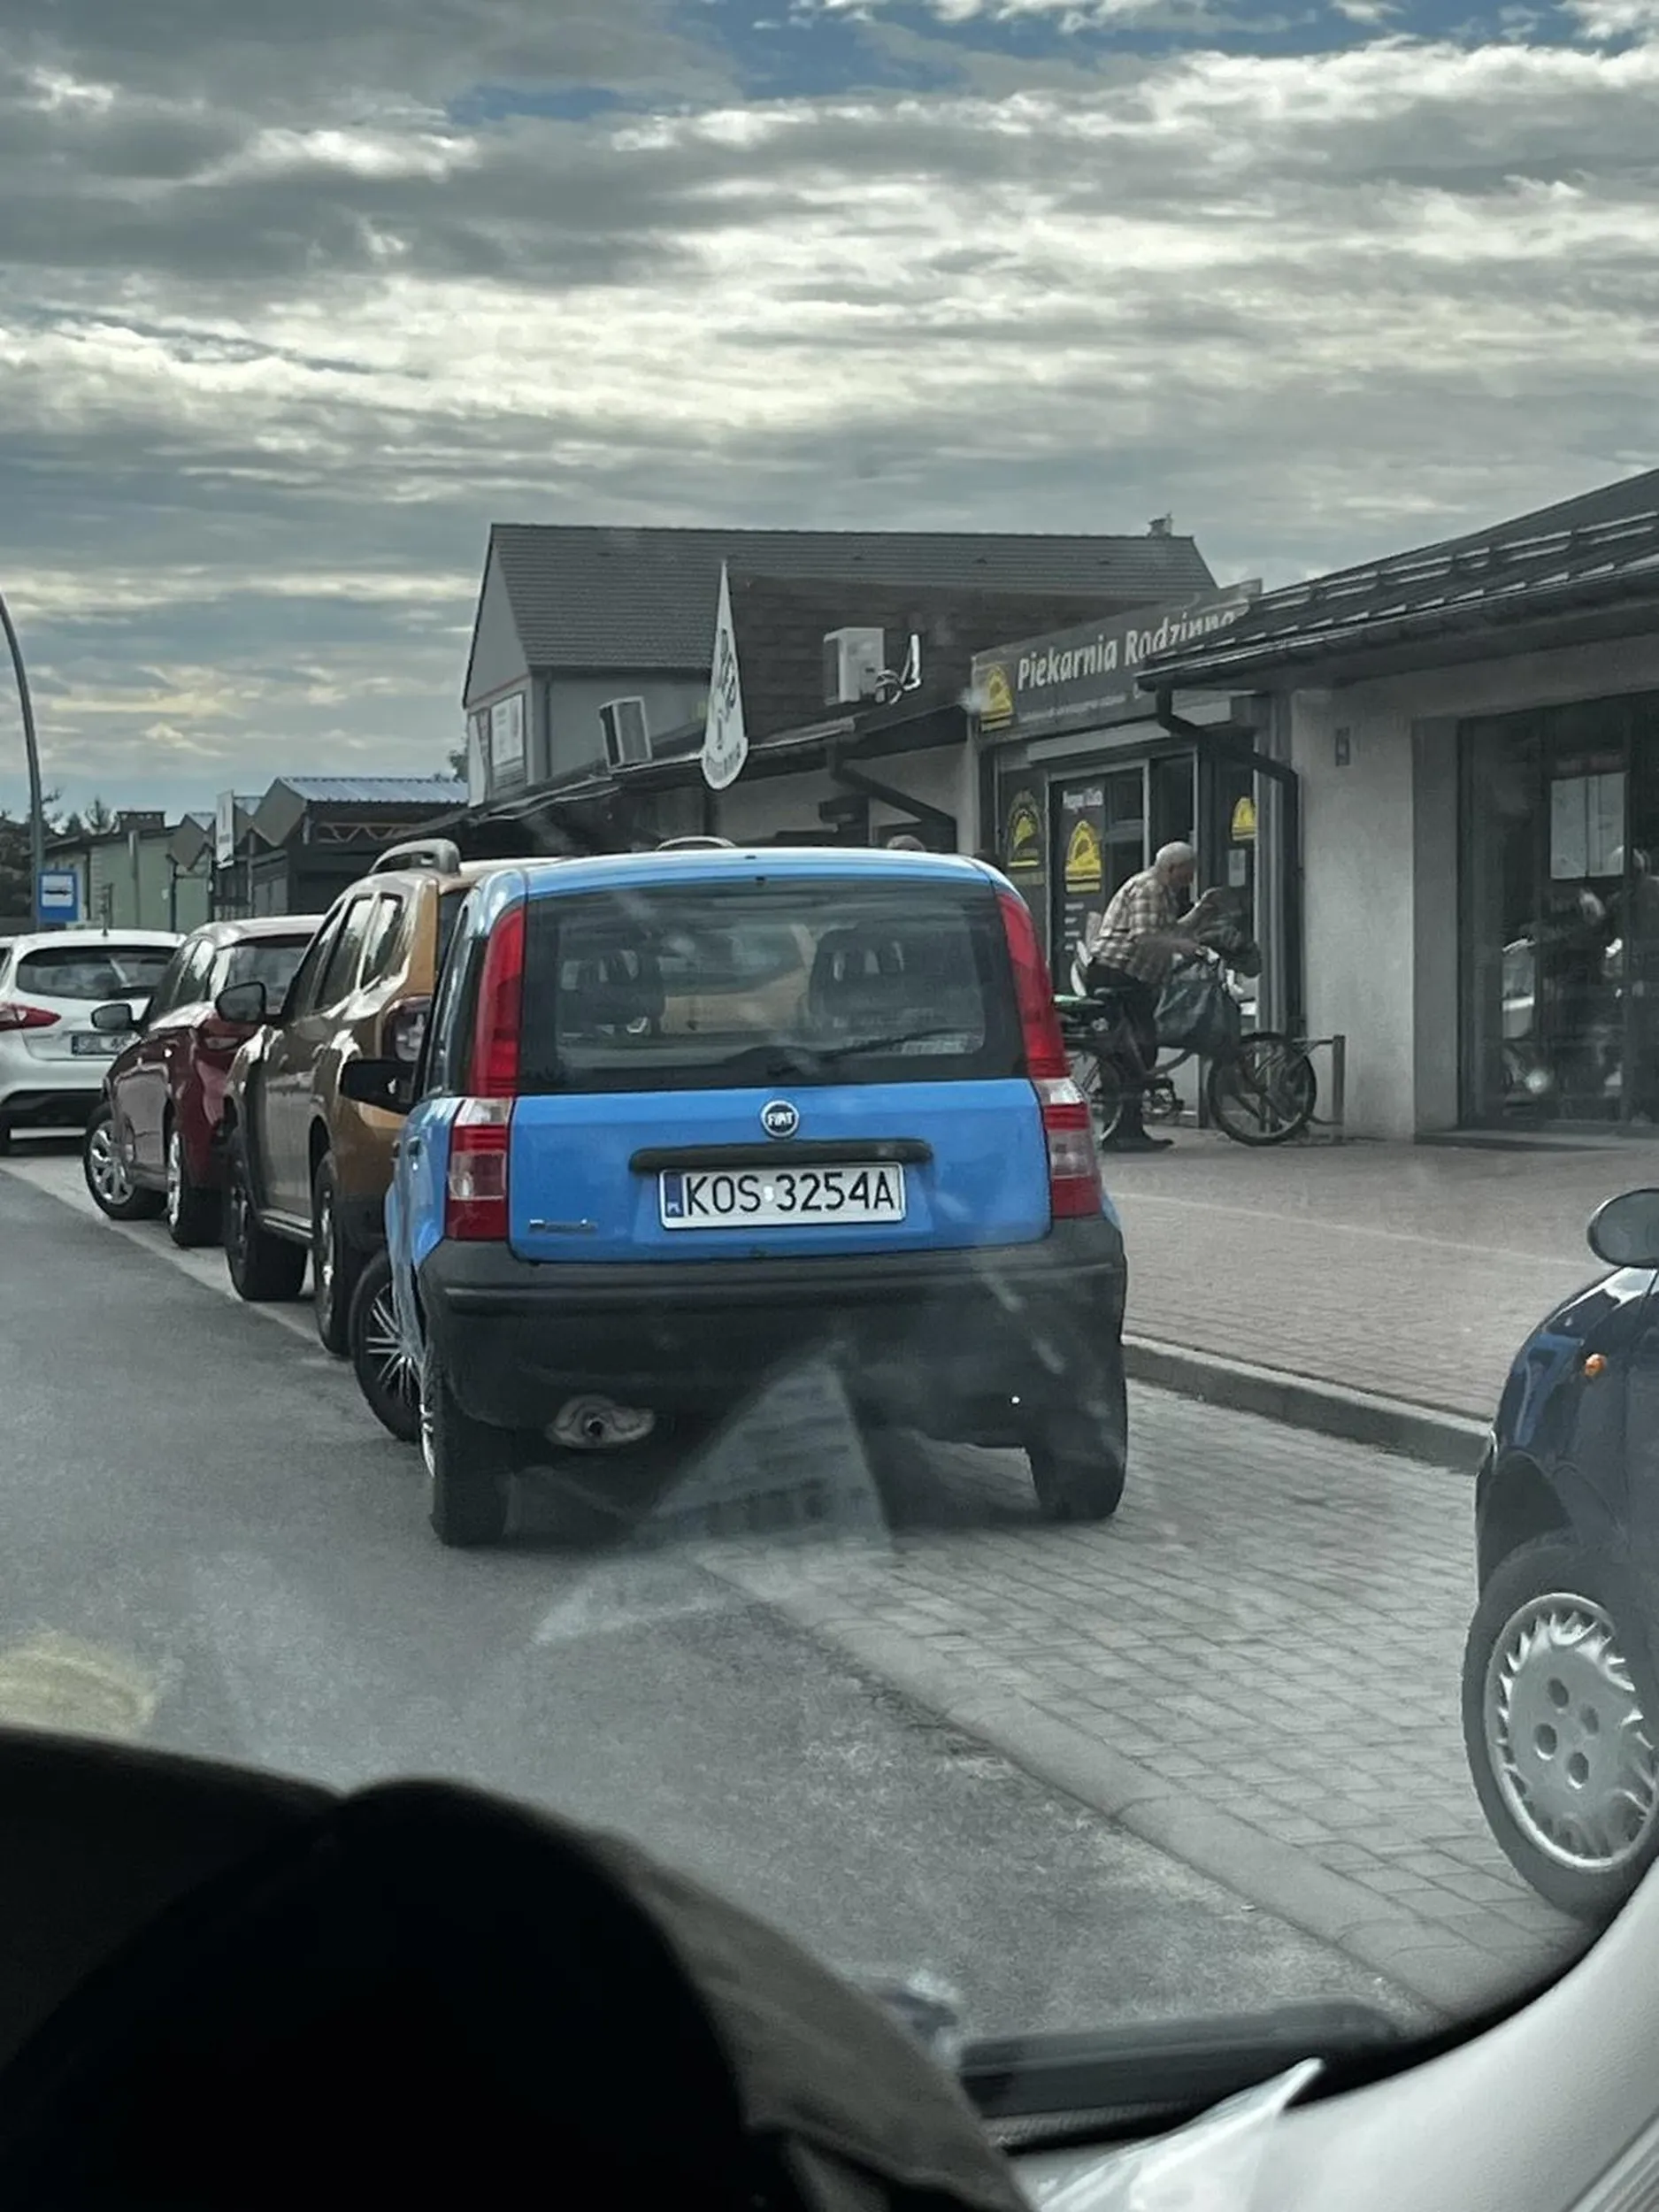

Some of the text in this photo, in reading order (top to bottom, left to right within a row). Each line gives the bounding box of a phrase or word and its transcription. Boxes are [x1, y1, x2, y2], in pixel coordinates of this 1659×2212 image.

[1018, 634, 1118, 691] Piekarnia
[768, 1111, 793, 1125] FIAT
[686, 1171, 895, 1216] KOS 3254A
